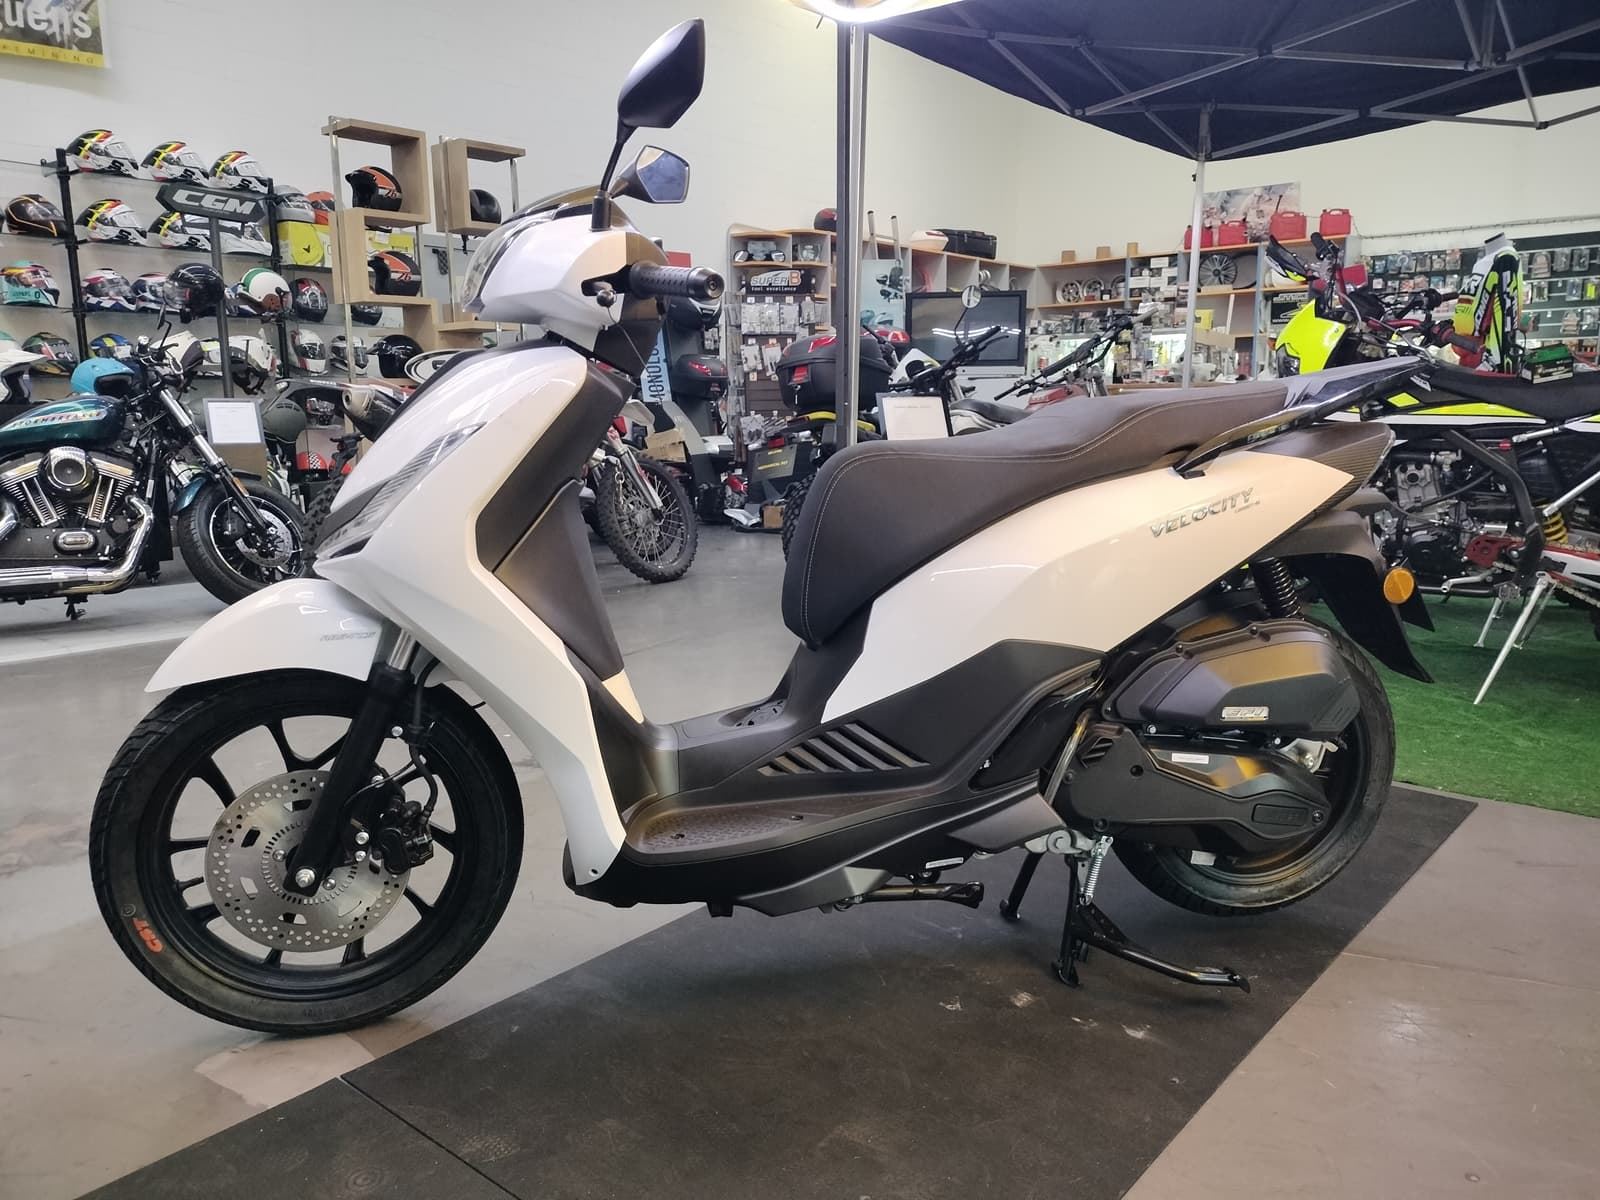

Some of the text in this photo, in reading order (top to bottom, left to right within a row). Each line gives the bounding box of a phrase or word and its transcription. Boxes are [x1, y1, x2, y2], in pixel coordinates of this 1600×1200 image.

[172, 189, 256, 214] CGM
[751, 270, 801, 287] SUPER B
[1150, 487, 1254, 538] VELOCITY
